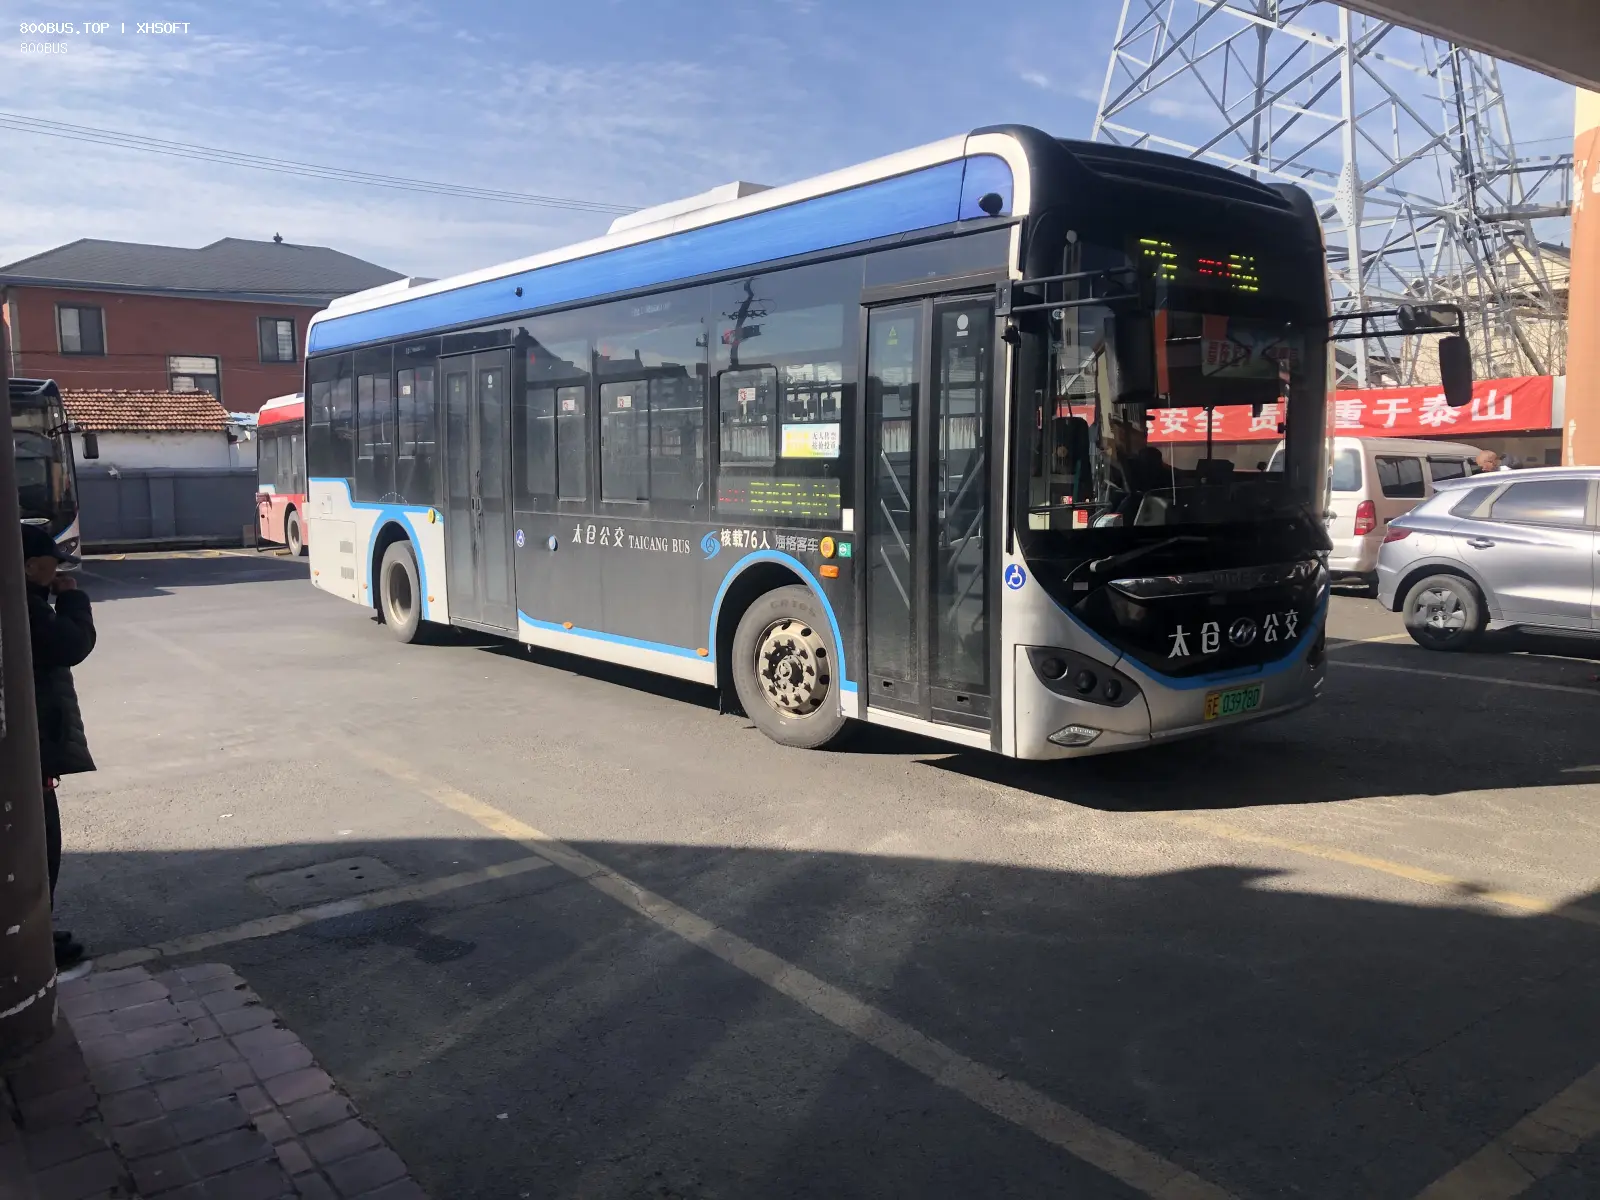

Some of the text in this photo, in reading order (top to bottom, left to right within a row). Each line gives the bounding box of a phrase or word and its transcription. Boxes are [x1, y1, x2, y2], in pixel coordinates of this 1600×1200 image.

[571, 524, 625, 548] 太仓公交
[628, 534, 691, 554] TAICANG BUS
[720, 528, 771, 550] 核载76人
[1167, 609, 1299, 659] 太仓 公交
